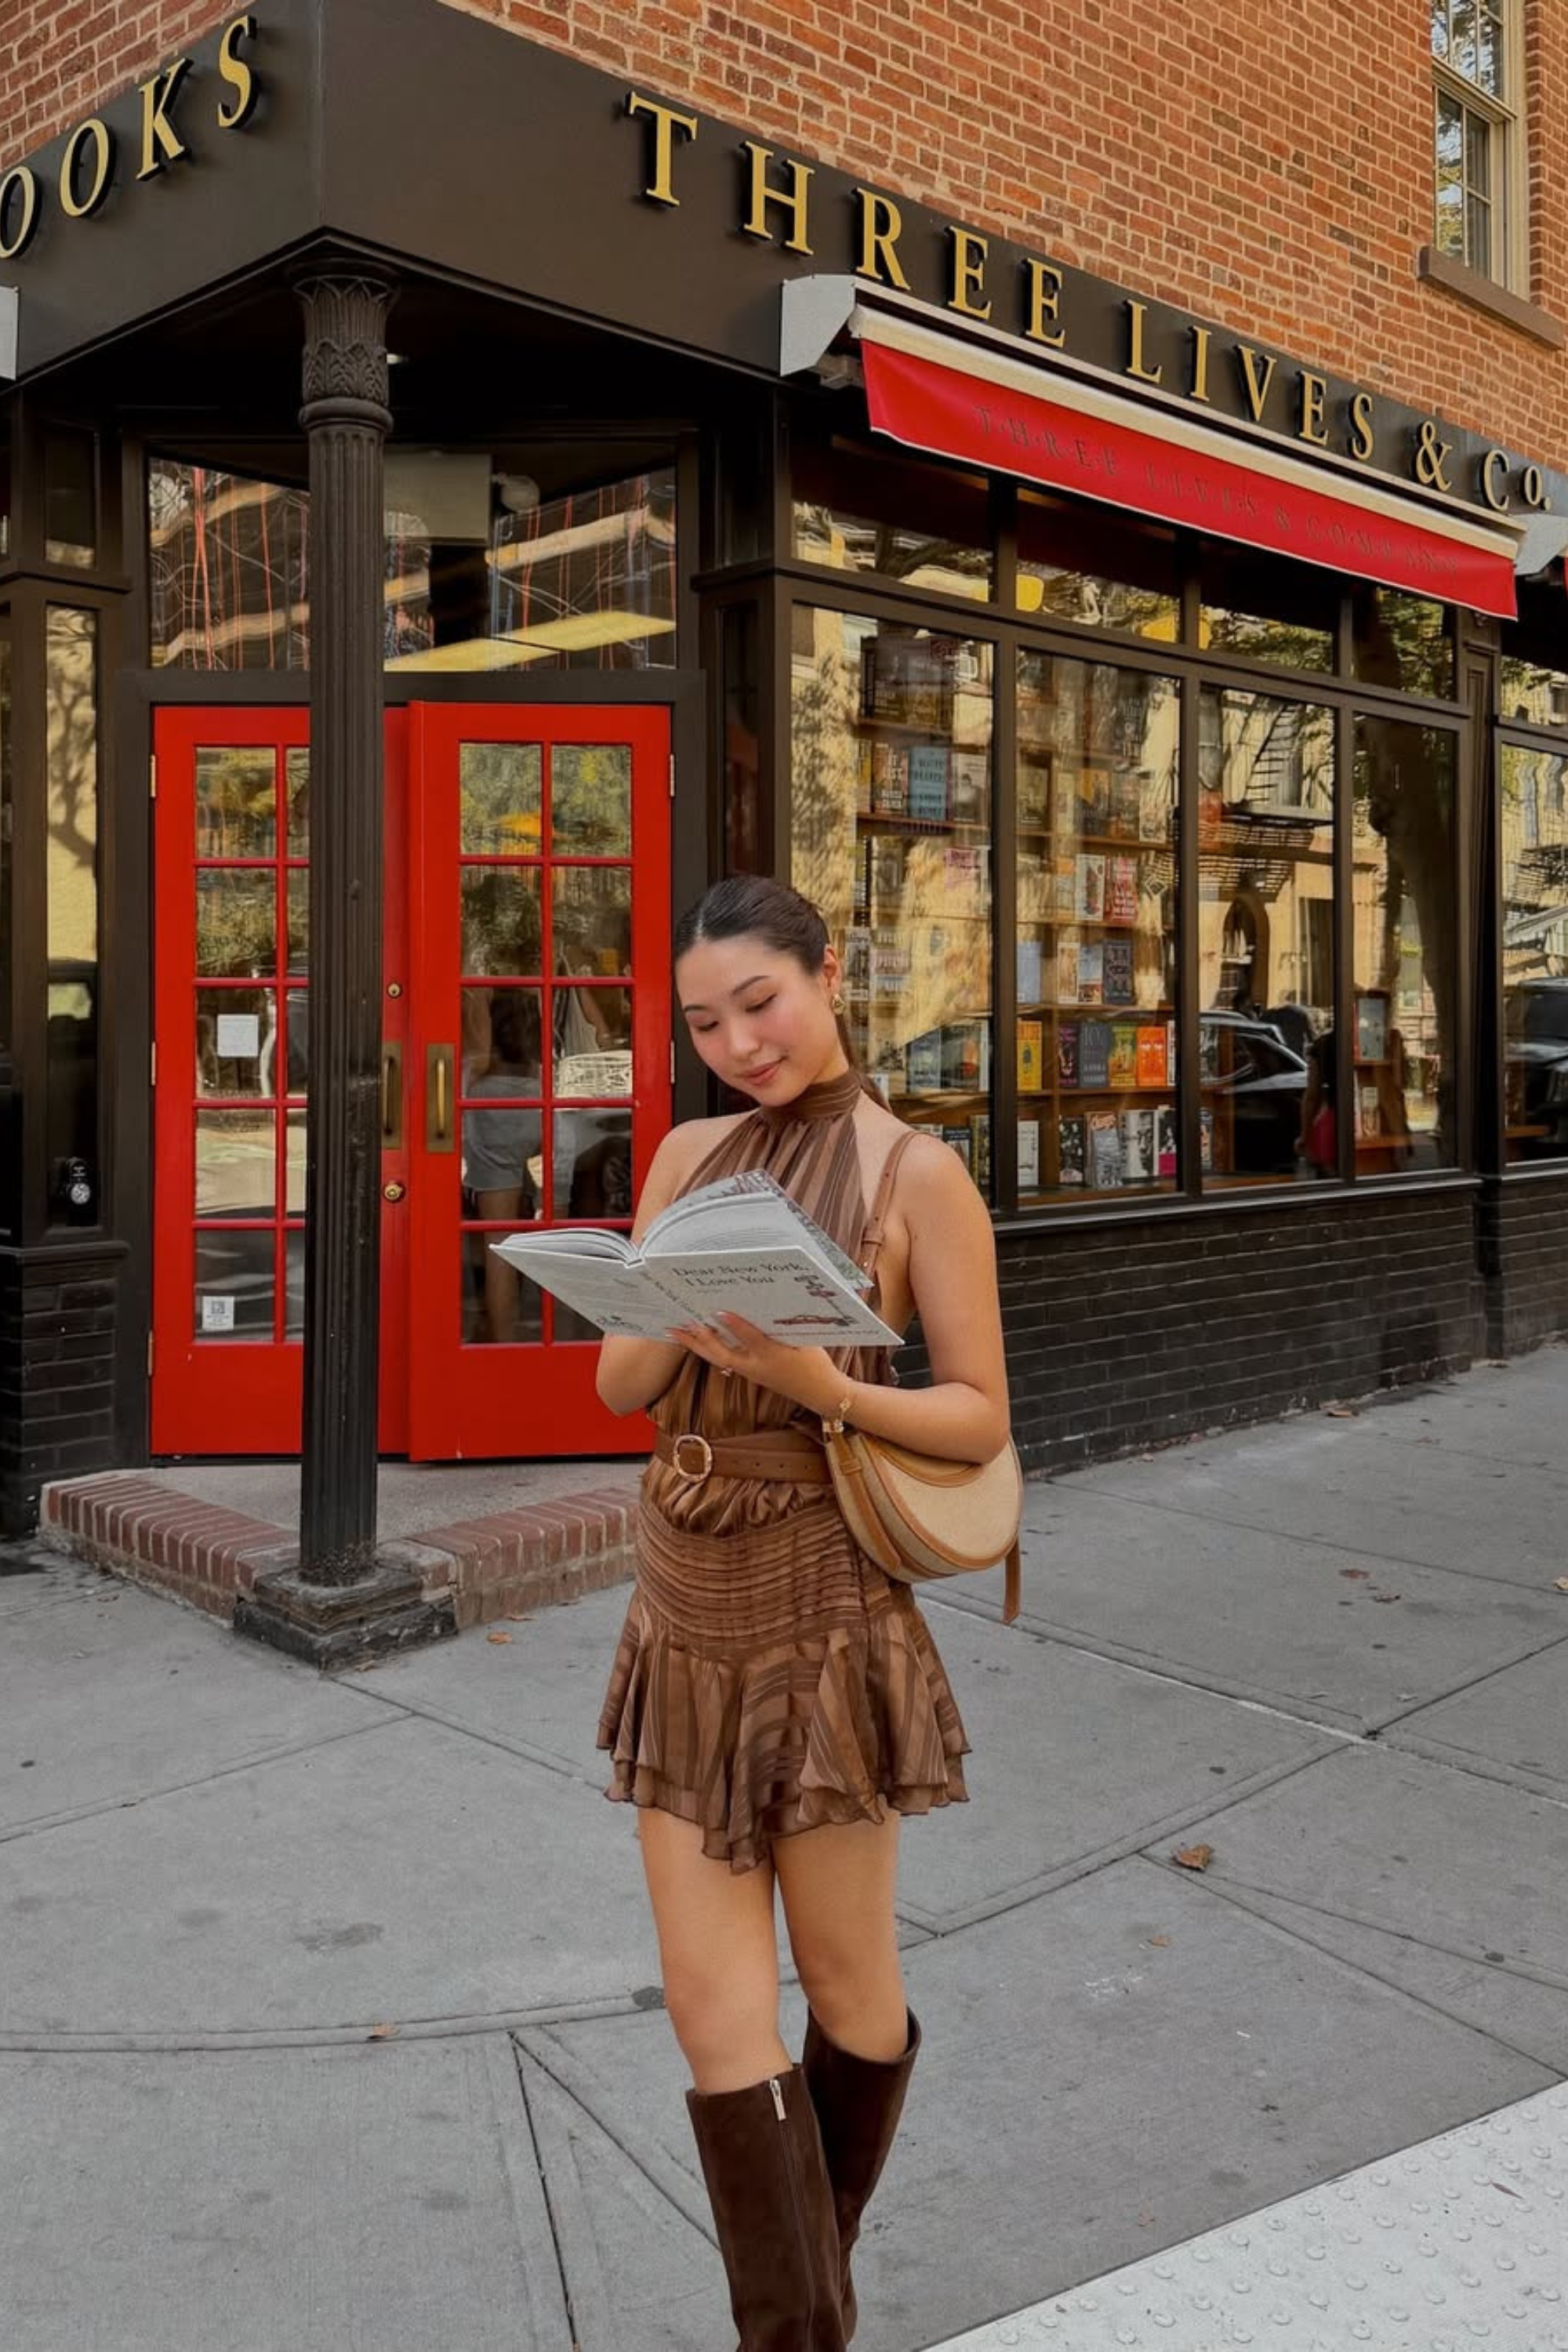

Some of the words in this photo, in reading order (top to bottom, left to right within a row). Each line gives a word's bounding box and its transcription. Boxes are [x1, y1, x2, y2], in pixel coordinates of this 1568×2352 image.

[626, 90, 1065, 348] THREE
[1124, 299, 1374, 460] LIVES
[1414, 419, 1453, 492] &
[672, 1267, 715, 1276] Dear
[717, 1265, 757, 1274] New
[739, 1275, 775, 1284] You
